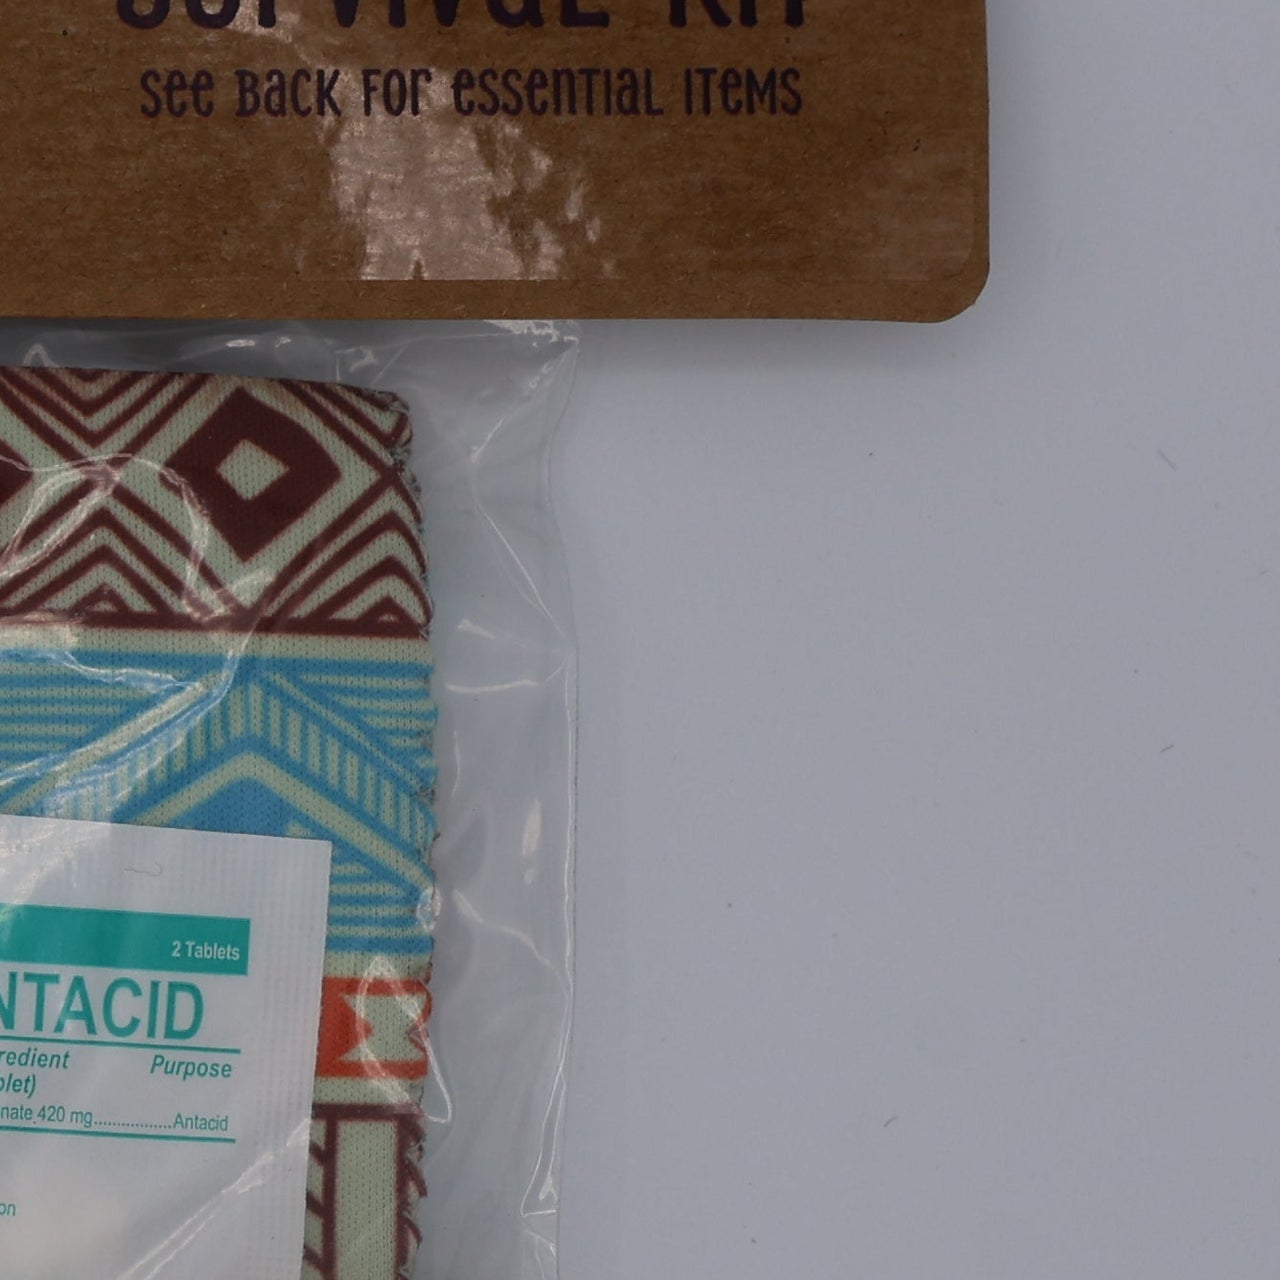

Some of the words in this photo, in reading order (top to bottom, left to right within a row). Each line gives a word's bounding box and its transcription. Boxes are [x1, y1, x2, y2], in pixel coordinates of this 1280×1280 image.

[171, 941, 181, 958] 2
[185, 940, 240, 961] Tablets
[150, 1054, 233, 1081] Purpose
[37, 1105, 65, 1122] 420
